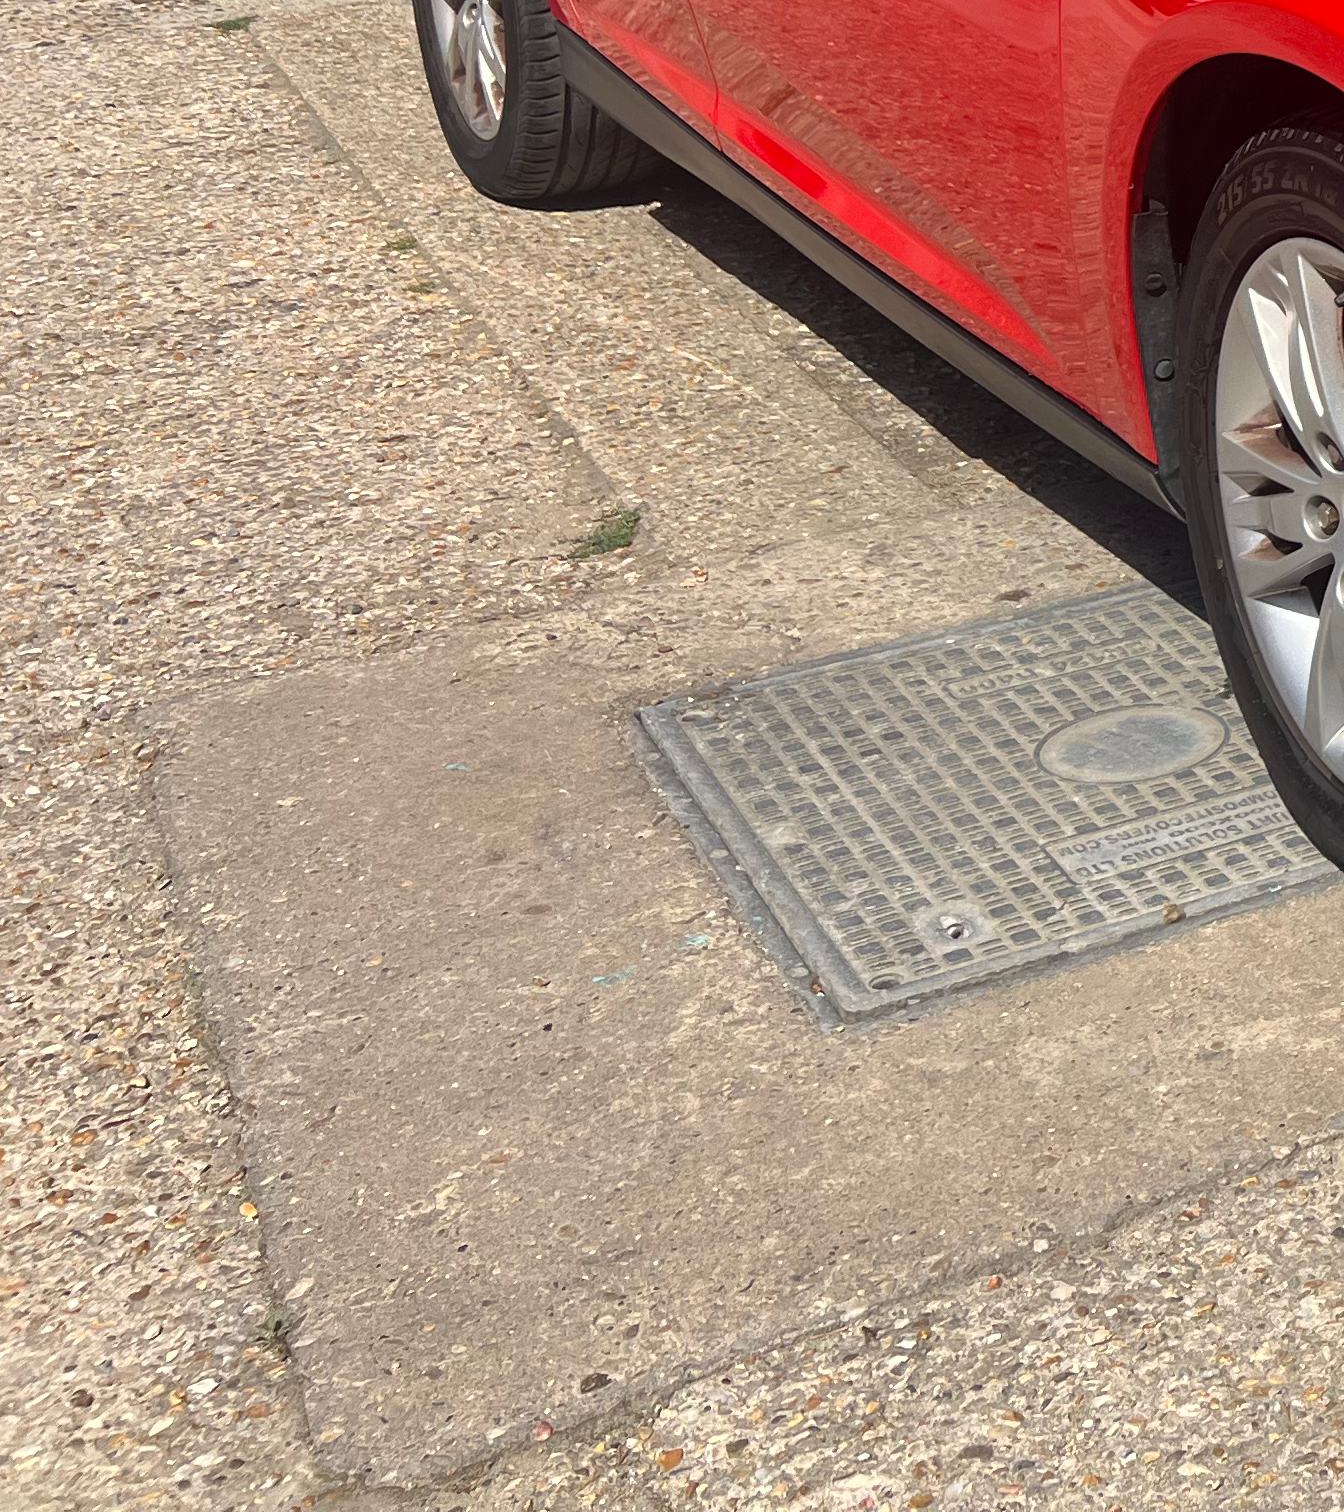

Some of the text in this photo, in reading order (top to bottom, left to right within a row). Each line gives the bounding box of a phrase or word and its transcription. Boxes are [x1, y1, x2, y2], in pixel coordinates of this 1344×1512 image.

[1055, 790, 1279, 857] OMPOSITECOVERS.COM
[1246, 811, 1290, 831] URT
[1120, 823, 1243, 866] SOLUTIONS
